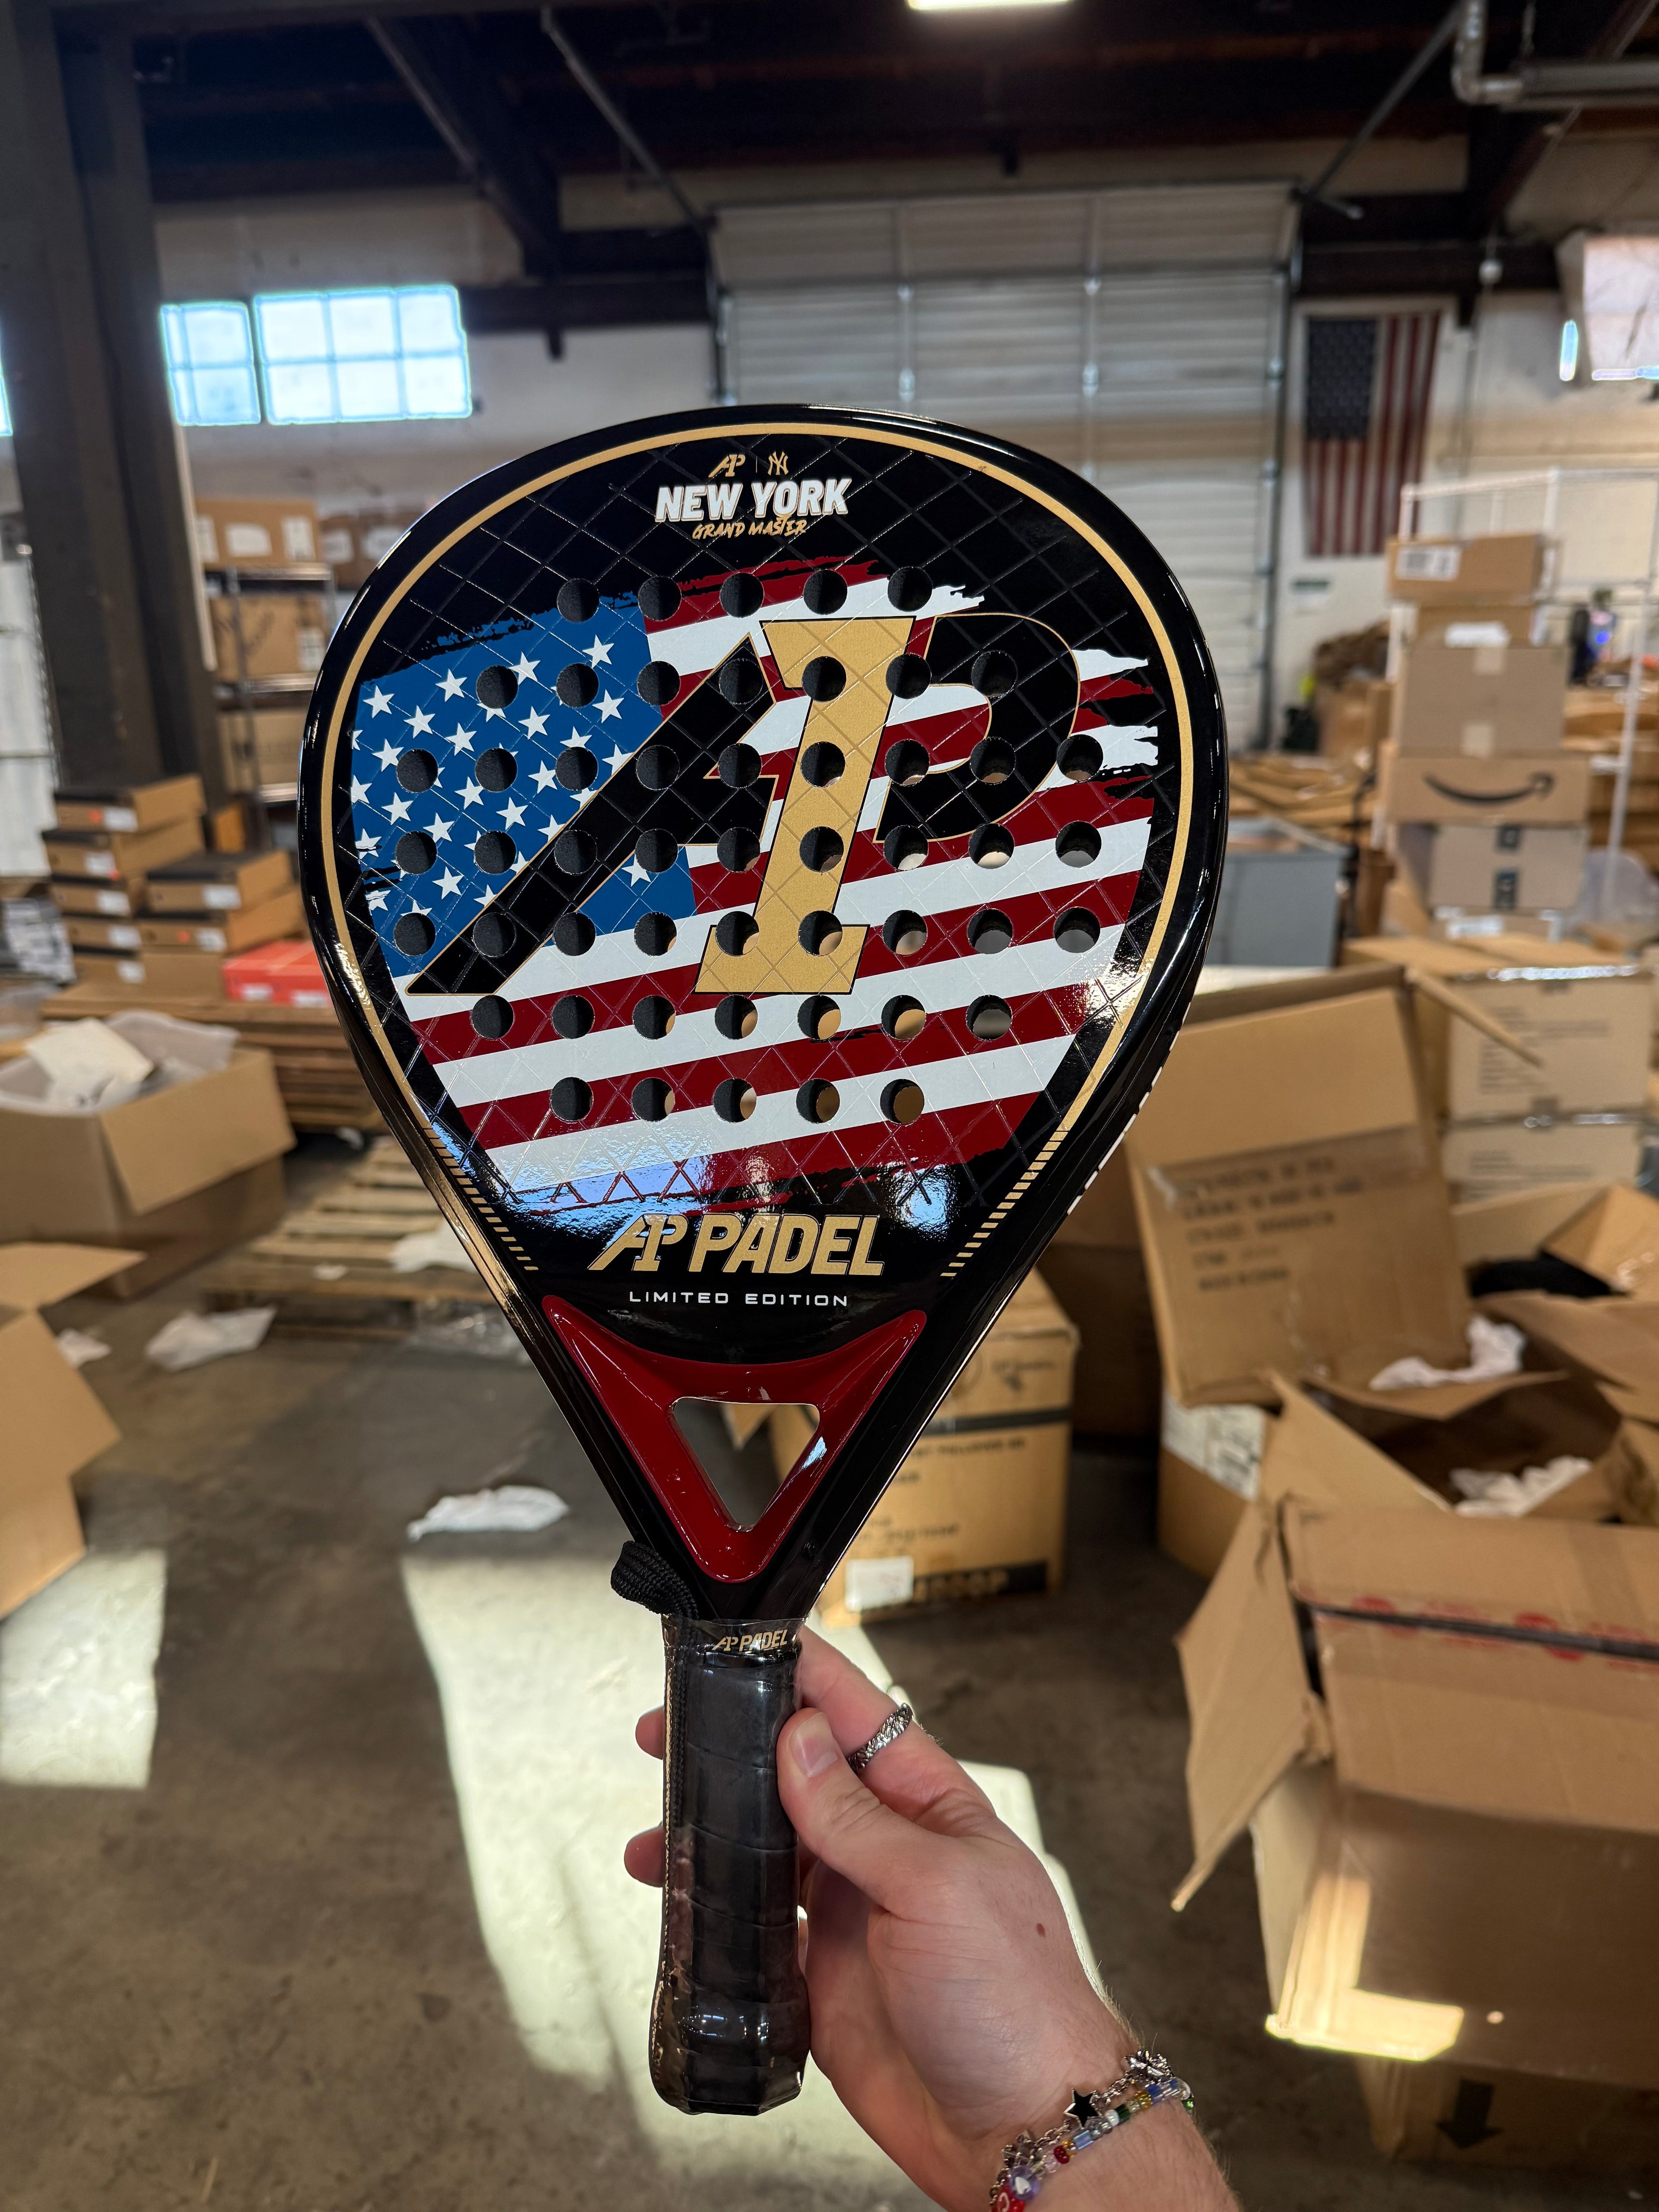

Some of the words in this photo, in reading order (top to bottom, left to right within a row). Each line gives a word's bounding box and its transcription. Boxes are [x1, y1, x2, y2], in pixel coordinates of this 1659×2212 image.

[708, 454, 746, 479] AP
[655, 483, 744, 523] NEW
[751, 478, 852, 518] YORK
[692, 521, 745, 540] GRAND
[748, 516, 807, 536] MASTER
[587, 1213, 688, 1271] AP
[688, 1213, 885, 1276] PADEL
[629, 1291, 729, 1305] LIMITED
[745, 1293, 848, 1307] EDITION
[712, 1636, 739, 1652] AP
[739, 1629, 788, 1652] PADEL
